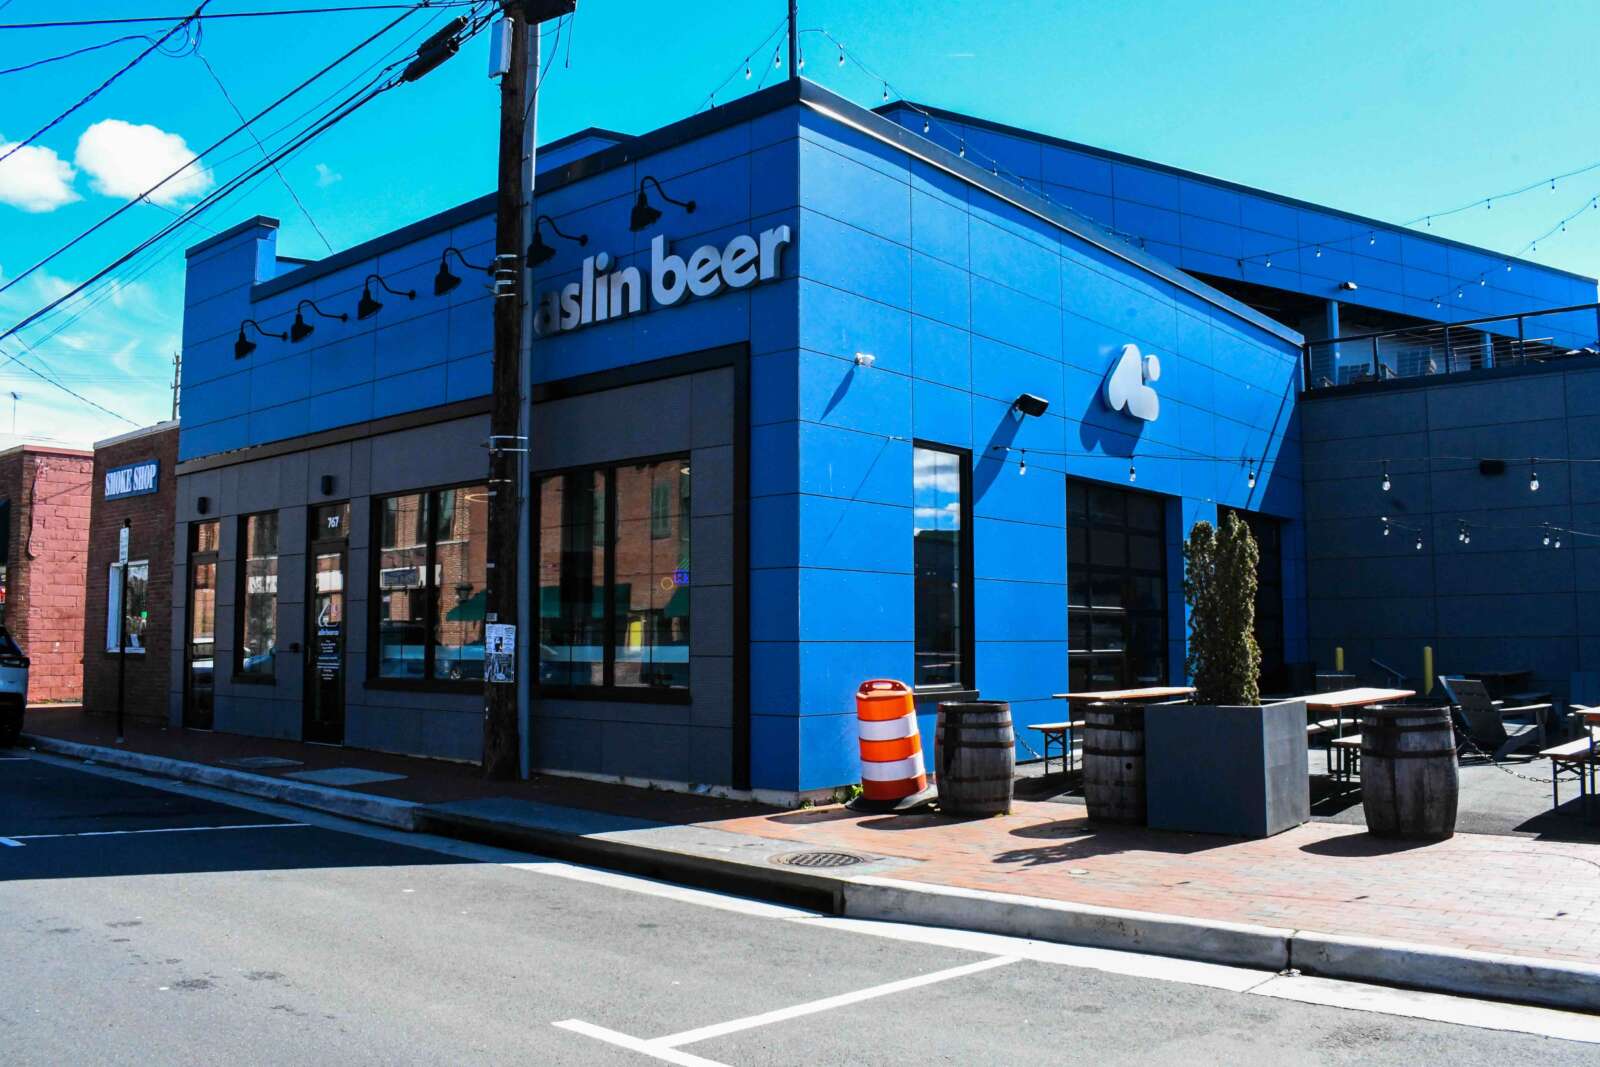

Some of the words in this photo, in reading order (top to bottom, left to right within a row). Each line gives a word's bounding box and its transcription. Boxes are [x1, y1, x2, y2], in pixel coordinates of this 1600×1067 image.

[533, 251, 642, 335] aslin
[651, 224, 791, 306] beer
[105, 468, 133, 496] SMOKE
[133, 464, 157, 491] SHOP
[327, 516, 340, 528] 767
